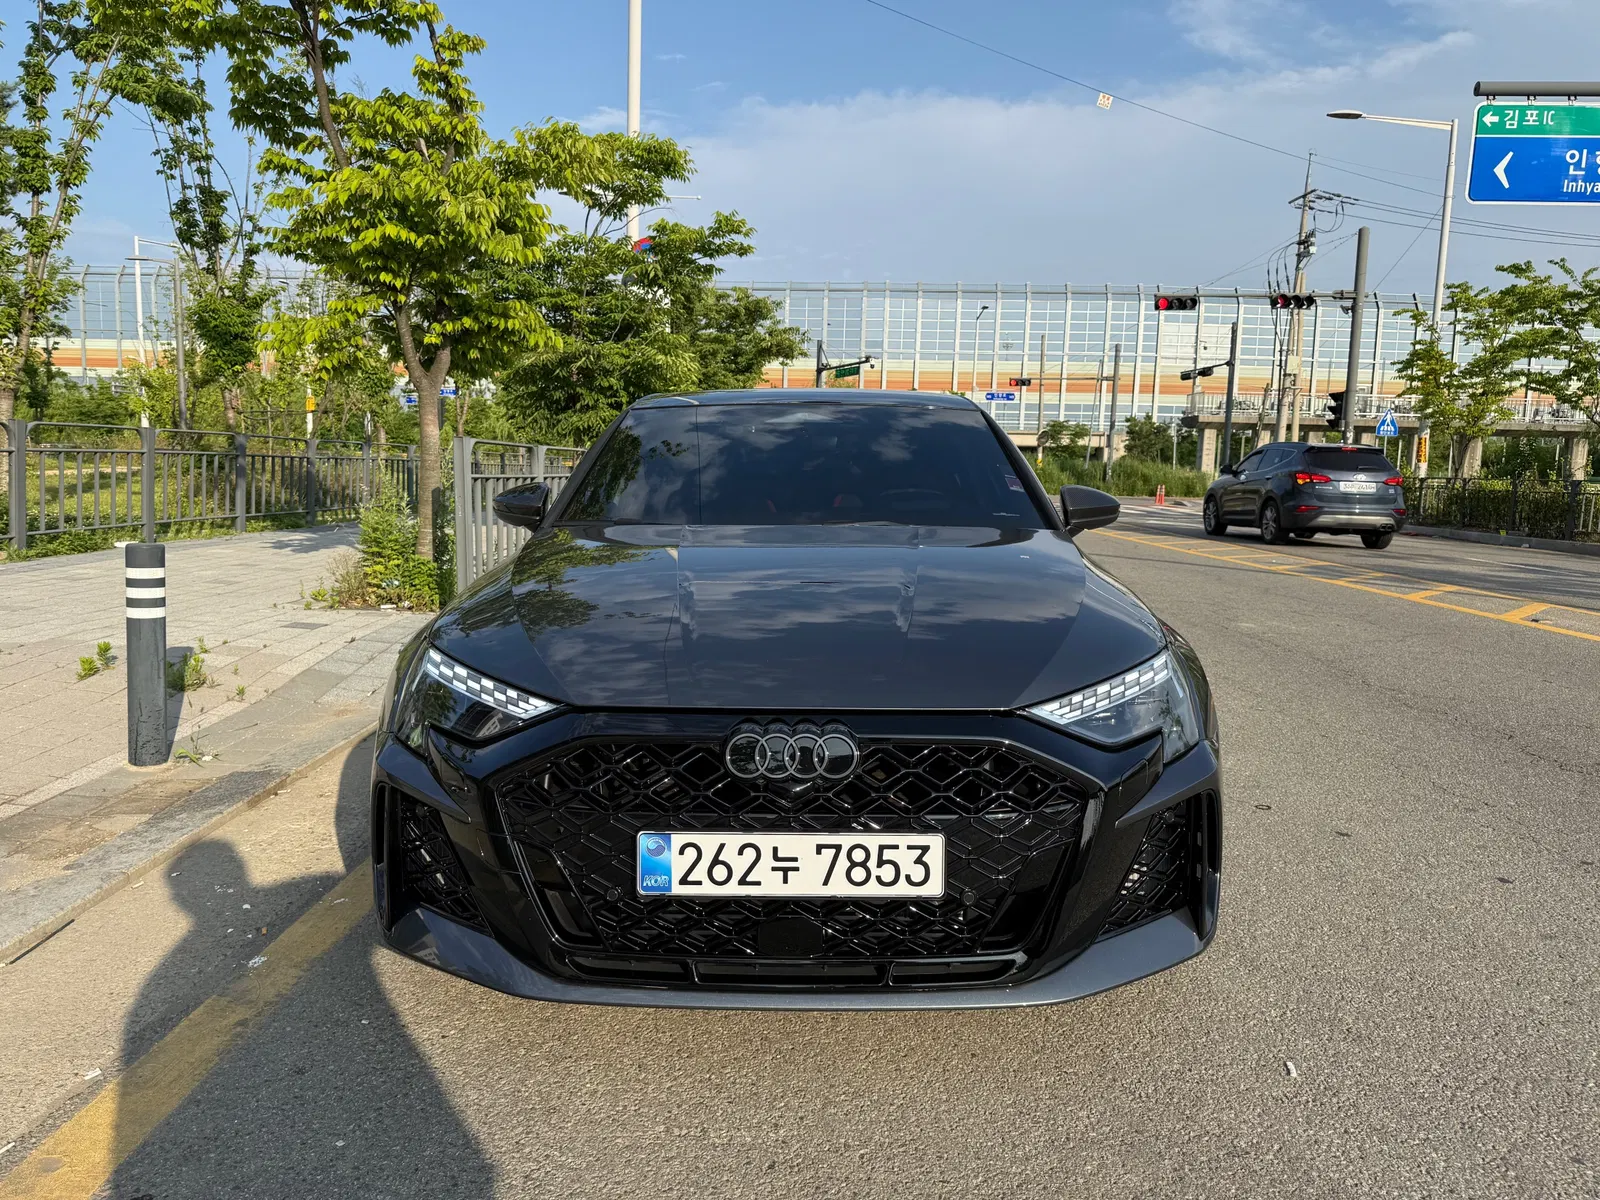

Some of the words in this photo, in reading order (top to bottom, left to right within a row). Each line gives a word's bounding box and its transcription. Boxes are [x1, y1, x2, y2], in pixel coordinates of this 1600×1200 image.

[678, 842, 801, 887] 262누
[815, 843, 931, 887] 7853
[642, 874, 670, 887] KOR
